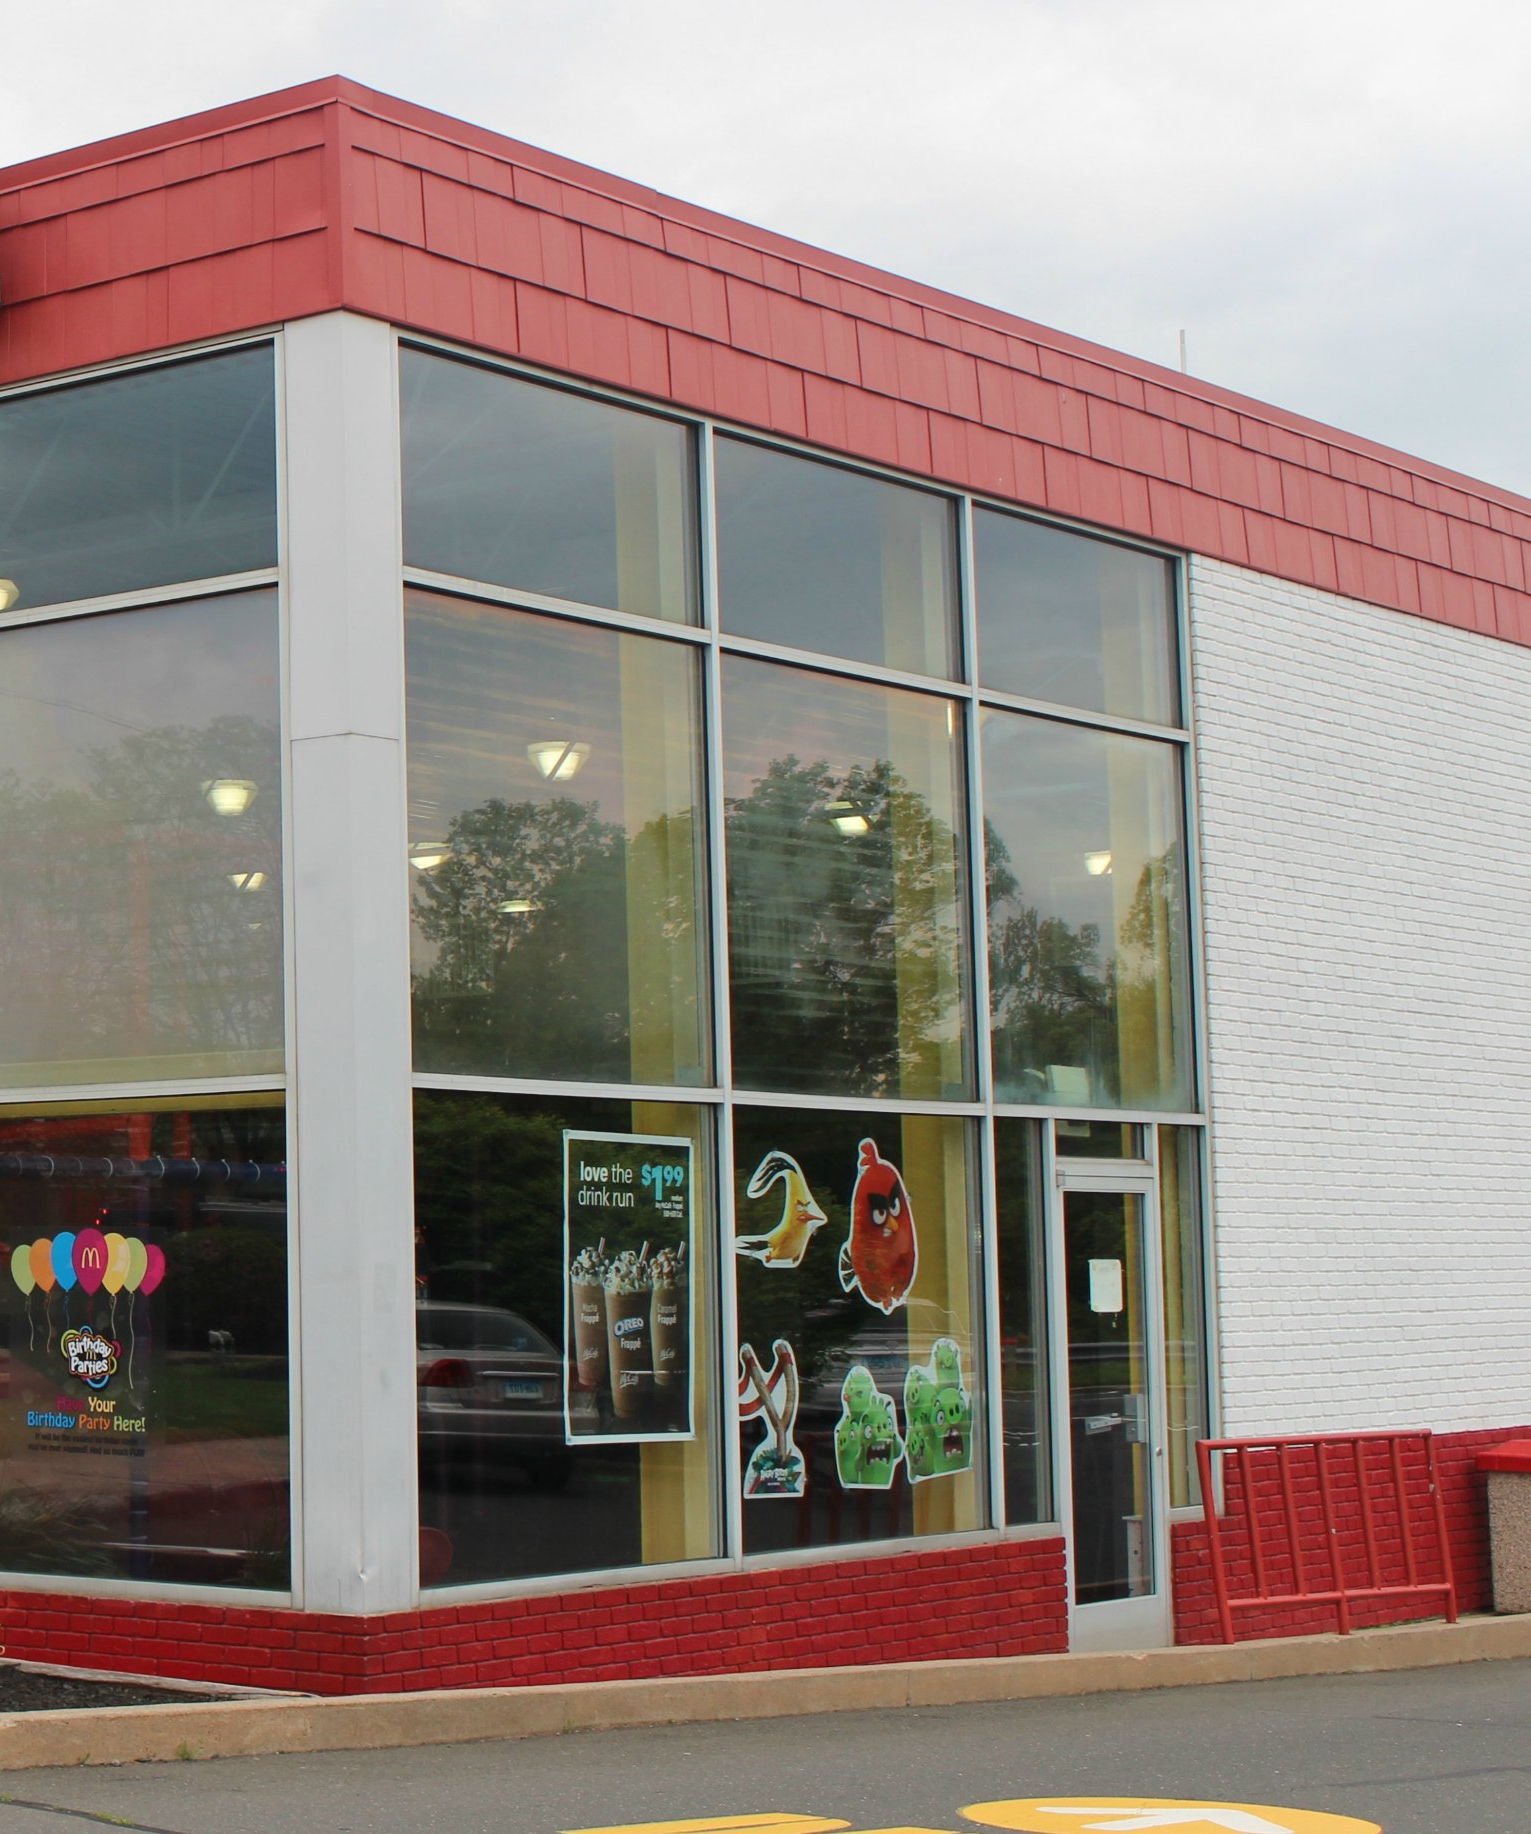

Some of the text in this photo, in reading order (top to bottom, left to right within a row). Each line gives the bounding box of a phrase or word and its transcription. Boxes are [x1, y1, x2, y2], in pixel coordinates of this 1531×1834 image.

[580, 1161, 633, 1183] love the
[578, 1185, 634, 1207] drink run
[614, 1317, 644, 1336] OREO
[68, 1336, 112, 1358] Birthday
[71, 1356, 108, 1376] Parties
[88, 1396, 116, 1412] Your
[27, 1411, 145, 1433] Birthday Party Here!
